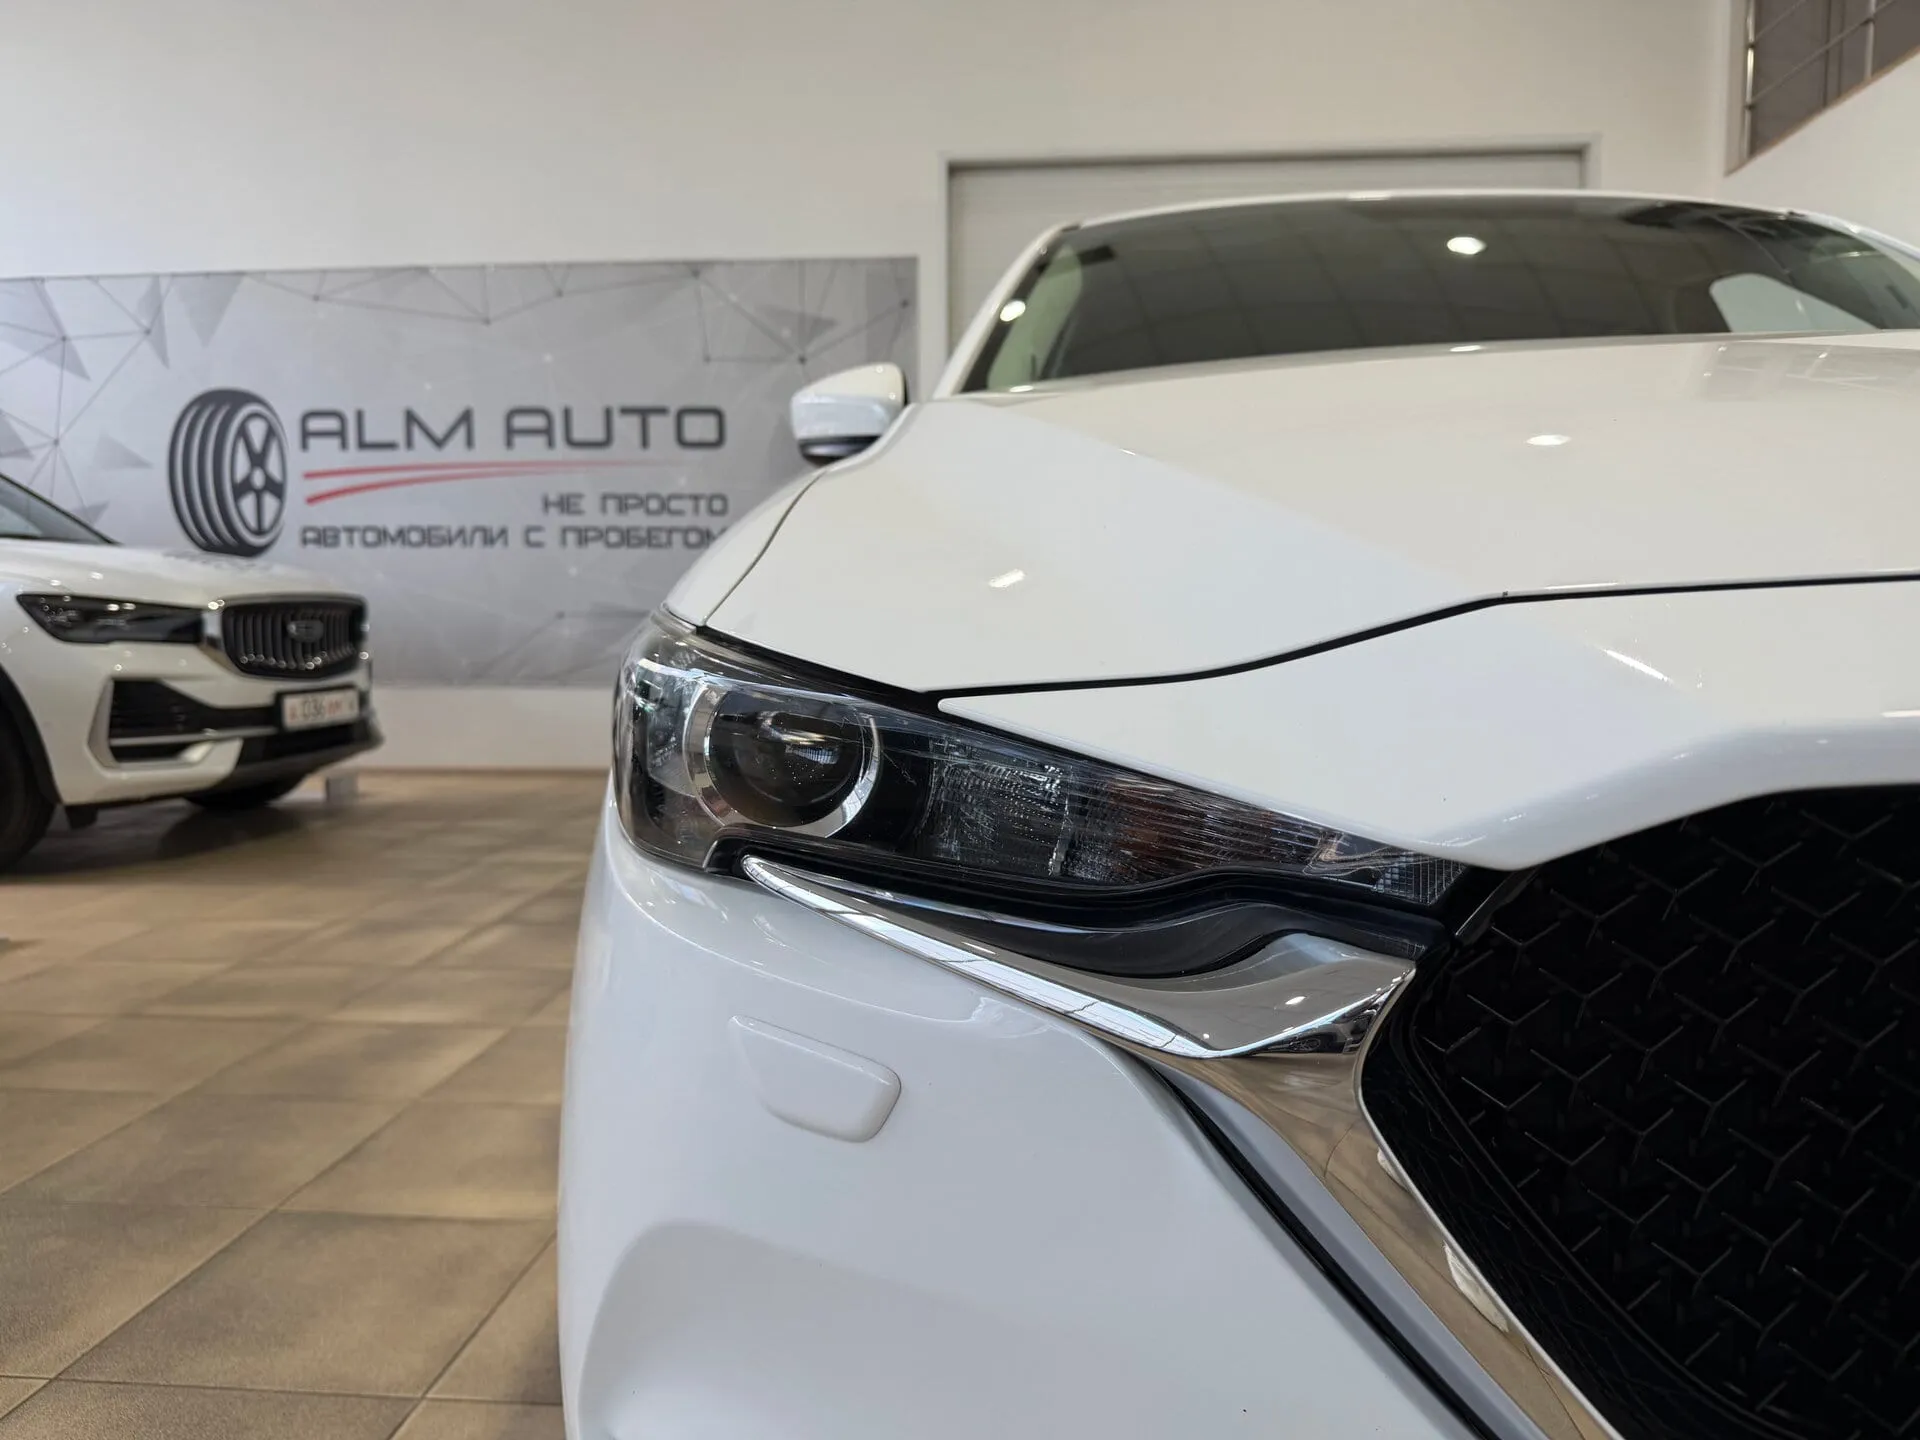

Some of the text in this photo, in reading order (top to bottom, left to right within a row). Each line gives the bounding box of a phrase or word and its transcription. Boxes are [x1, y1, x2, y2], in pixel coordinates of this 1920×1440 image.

[300, 404, 727, 451] ALM AUTO
[542, 491, 730, 516] НЕ ПРОСТО
[300, 525, 510, 549] АВТОМОБИЛИ
[524, 525, 546, 549] С
